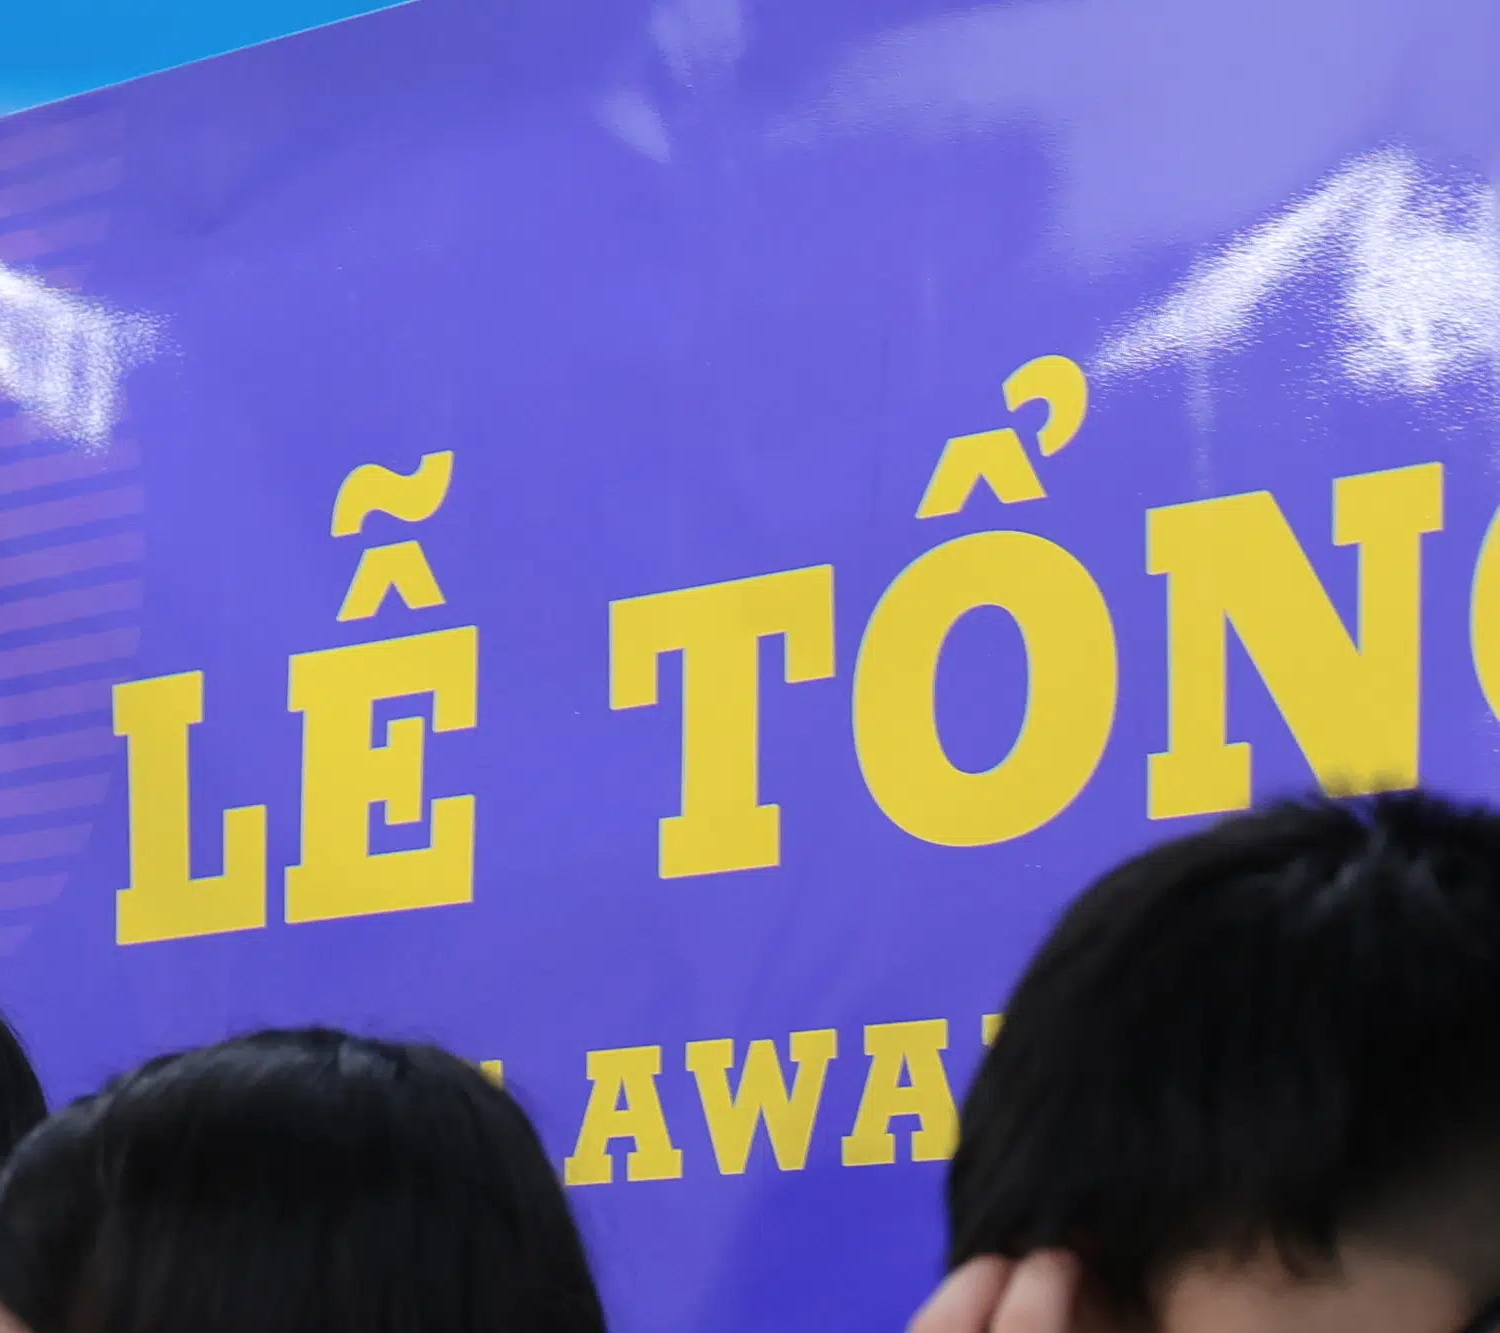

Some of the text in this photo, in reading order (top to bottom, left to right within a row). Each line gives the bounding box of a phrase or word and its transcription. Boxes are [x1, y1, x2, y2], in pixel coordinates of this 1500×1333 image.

[112, 354, 1500, 945] LỄ TỔN
[564, 1012, 1004, 1187] AWA
